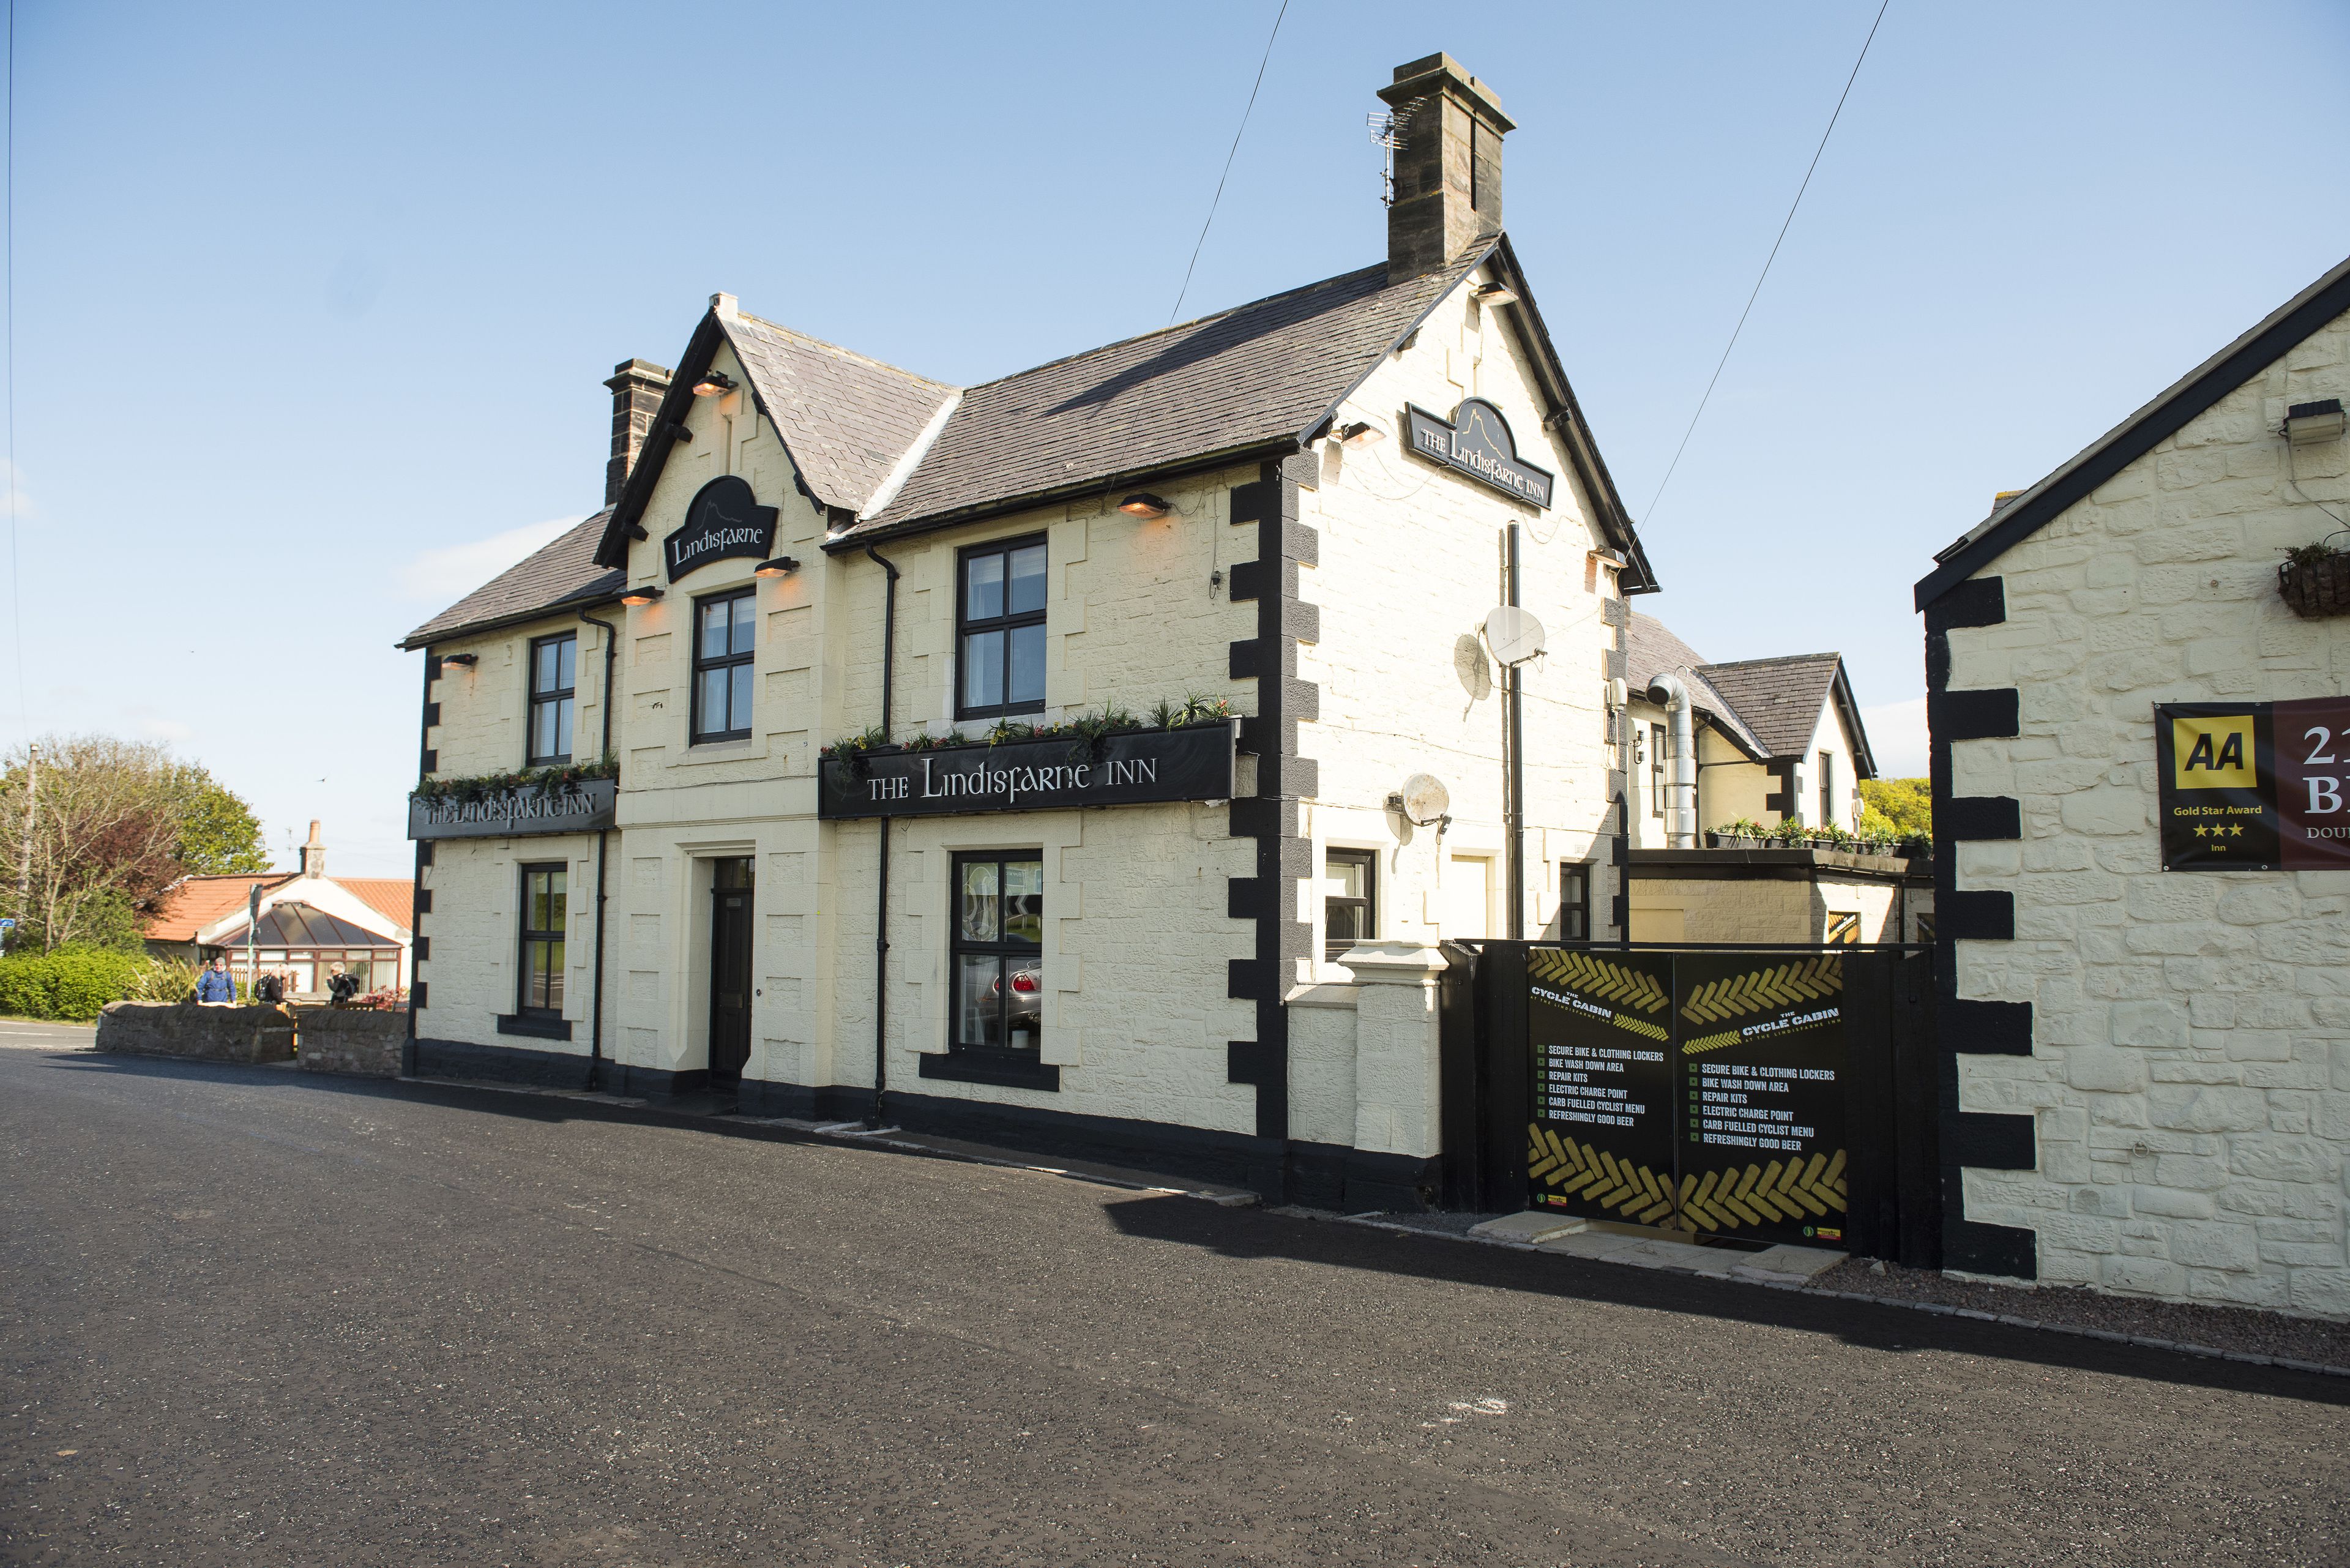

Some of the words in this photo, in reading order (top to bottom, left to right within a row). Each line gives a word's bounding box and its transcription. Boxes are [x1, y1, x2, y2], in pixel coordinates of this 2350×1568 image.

[1421, 428, 1445, 453] THE
[1525, 479, 1545, 500] INN
[2184, 732, 2244, 771] AA
[867, 776, 909, 801] THE
[1106, 758, 1158, 786] INN
[2302, 776, 2350, 813] B
[561, 793, 595, 815] INN
[2174, 807, 2199, 815] Gold
[2202, 807, 2224, 815] Star
[2226, 805, 2262, 815] Award
[2306, 827, 2350, 838] DOU
[1531, 987, 1570, 1005] CYCLE
[1572, 999, 1612, 1018] CABIN
[1554, 1003, 1595, 1020] LINDISFARNE
[1742, 1019, 1790, 1036] CYCLE
[1792, 1007, 1839, 1025] CABIN
[1774, 1022, 1824, 1036] LINDISFARNE
[1549, 1045, 1573, 1056] SECURE
[1575, 1047, 1590, 1057] BIKE
[1591, 1048, 1597, 1058] &
[1598, 1048, 1631, 1059] CLOTHING
[1633, 1051, 1664, 1062] LOCKERS
[1549, 1058, 1564, 1068] BIKE
[1565, 1059, 1583, 1069] WASH
[1585, 1061, 1605, 1070] DOWN
[1606, 1062, 1624, 1072] AREA
[1702, 1064, 1730, 1075] SECURE
[1732, 1065, 1749, 1076] BIKE
[1751, 1066, 1758, 1077] &
[1759, 1067, 1797, 1078] CLOTHING
[1799, 1069, 1835, 1081] LOCKERS
[1549, 1071, 1572, 1081] REPAIR
[1573, 1073, 1587, 1083] KITS
[1702, 1078, 1719, 1088] BIKE
[1720, 1078, 1742, 1089] WASH
[1744, 1080, 1767, 1091] DOWN
[1769, 1081, 1789, 1092] AREA
[1549, 1084, 1578, 1095] ELECTRIC
[1580, 1086, 1606, 1097] CHARGE
[1608, 1088, 1628, 1099] POINT
[1703, 1091, 1729, 1102] REPAIR
[1731, 1093, 1747, 1104] KITS
[1549, 1097, 1565, 1107] CARB
[1567, 1098, 1595, 1110] FUELLED
[1597, 1100, 1624, 1112] CYCLIST
[1625, 1103, 1645, 1114] MENU
[1703, 1105, 1737, 1118] ELECTRIC
[1739, 1108, 1769, 1119] CHARGE
[1770, 1110, 1794, 1121] POINT
[1549, 1110, 1595, 1122] REFRESHINGLY
[1597, 1114, 1615, 1125] GOOD
[1617, 1116, 1634, 1127] BEER
[1703, 1119, 1722, 1130] CARB
[1725, 1121, 1756, 1133] FUELLED
[1758, 1124, 1789, 1135] CYCLIST
[1791, 1126, 1815, 1138] MENU
[1703, 1133, 1757, 1147] REFRESHINGLY
[1759, 1138, 1780, 1149] GOOD
[1781, 1140, 1802, 1151] BEER
